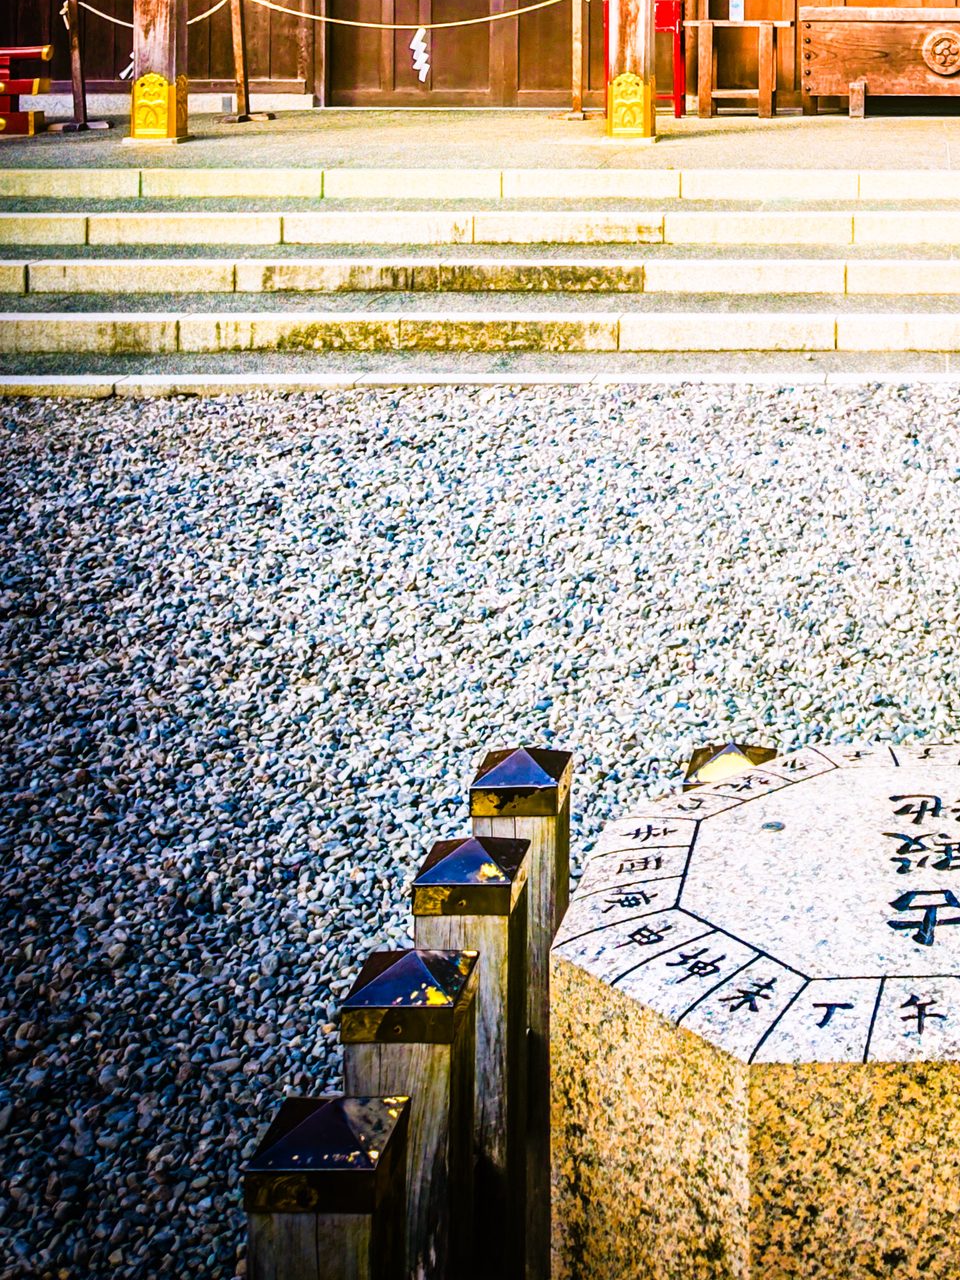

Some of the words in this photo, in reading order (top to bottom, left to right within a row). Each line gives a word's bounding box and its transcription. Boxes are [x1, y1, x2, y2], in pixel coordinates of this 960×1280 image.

[619, 824, 679, 842] 辛
[615, 850, 664, 874] 酉
[601, 888, 659, 914] 庚
[613, 924, 673, 949] 申
[665, 948, 727, 984] 坤
[717, 977, 778, 1013] 未
[812, 1002, 855, 1029] 丁
[900, 994, 948, 1036] 午
